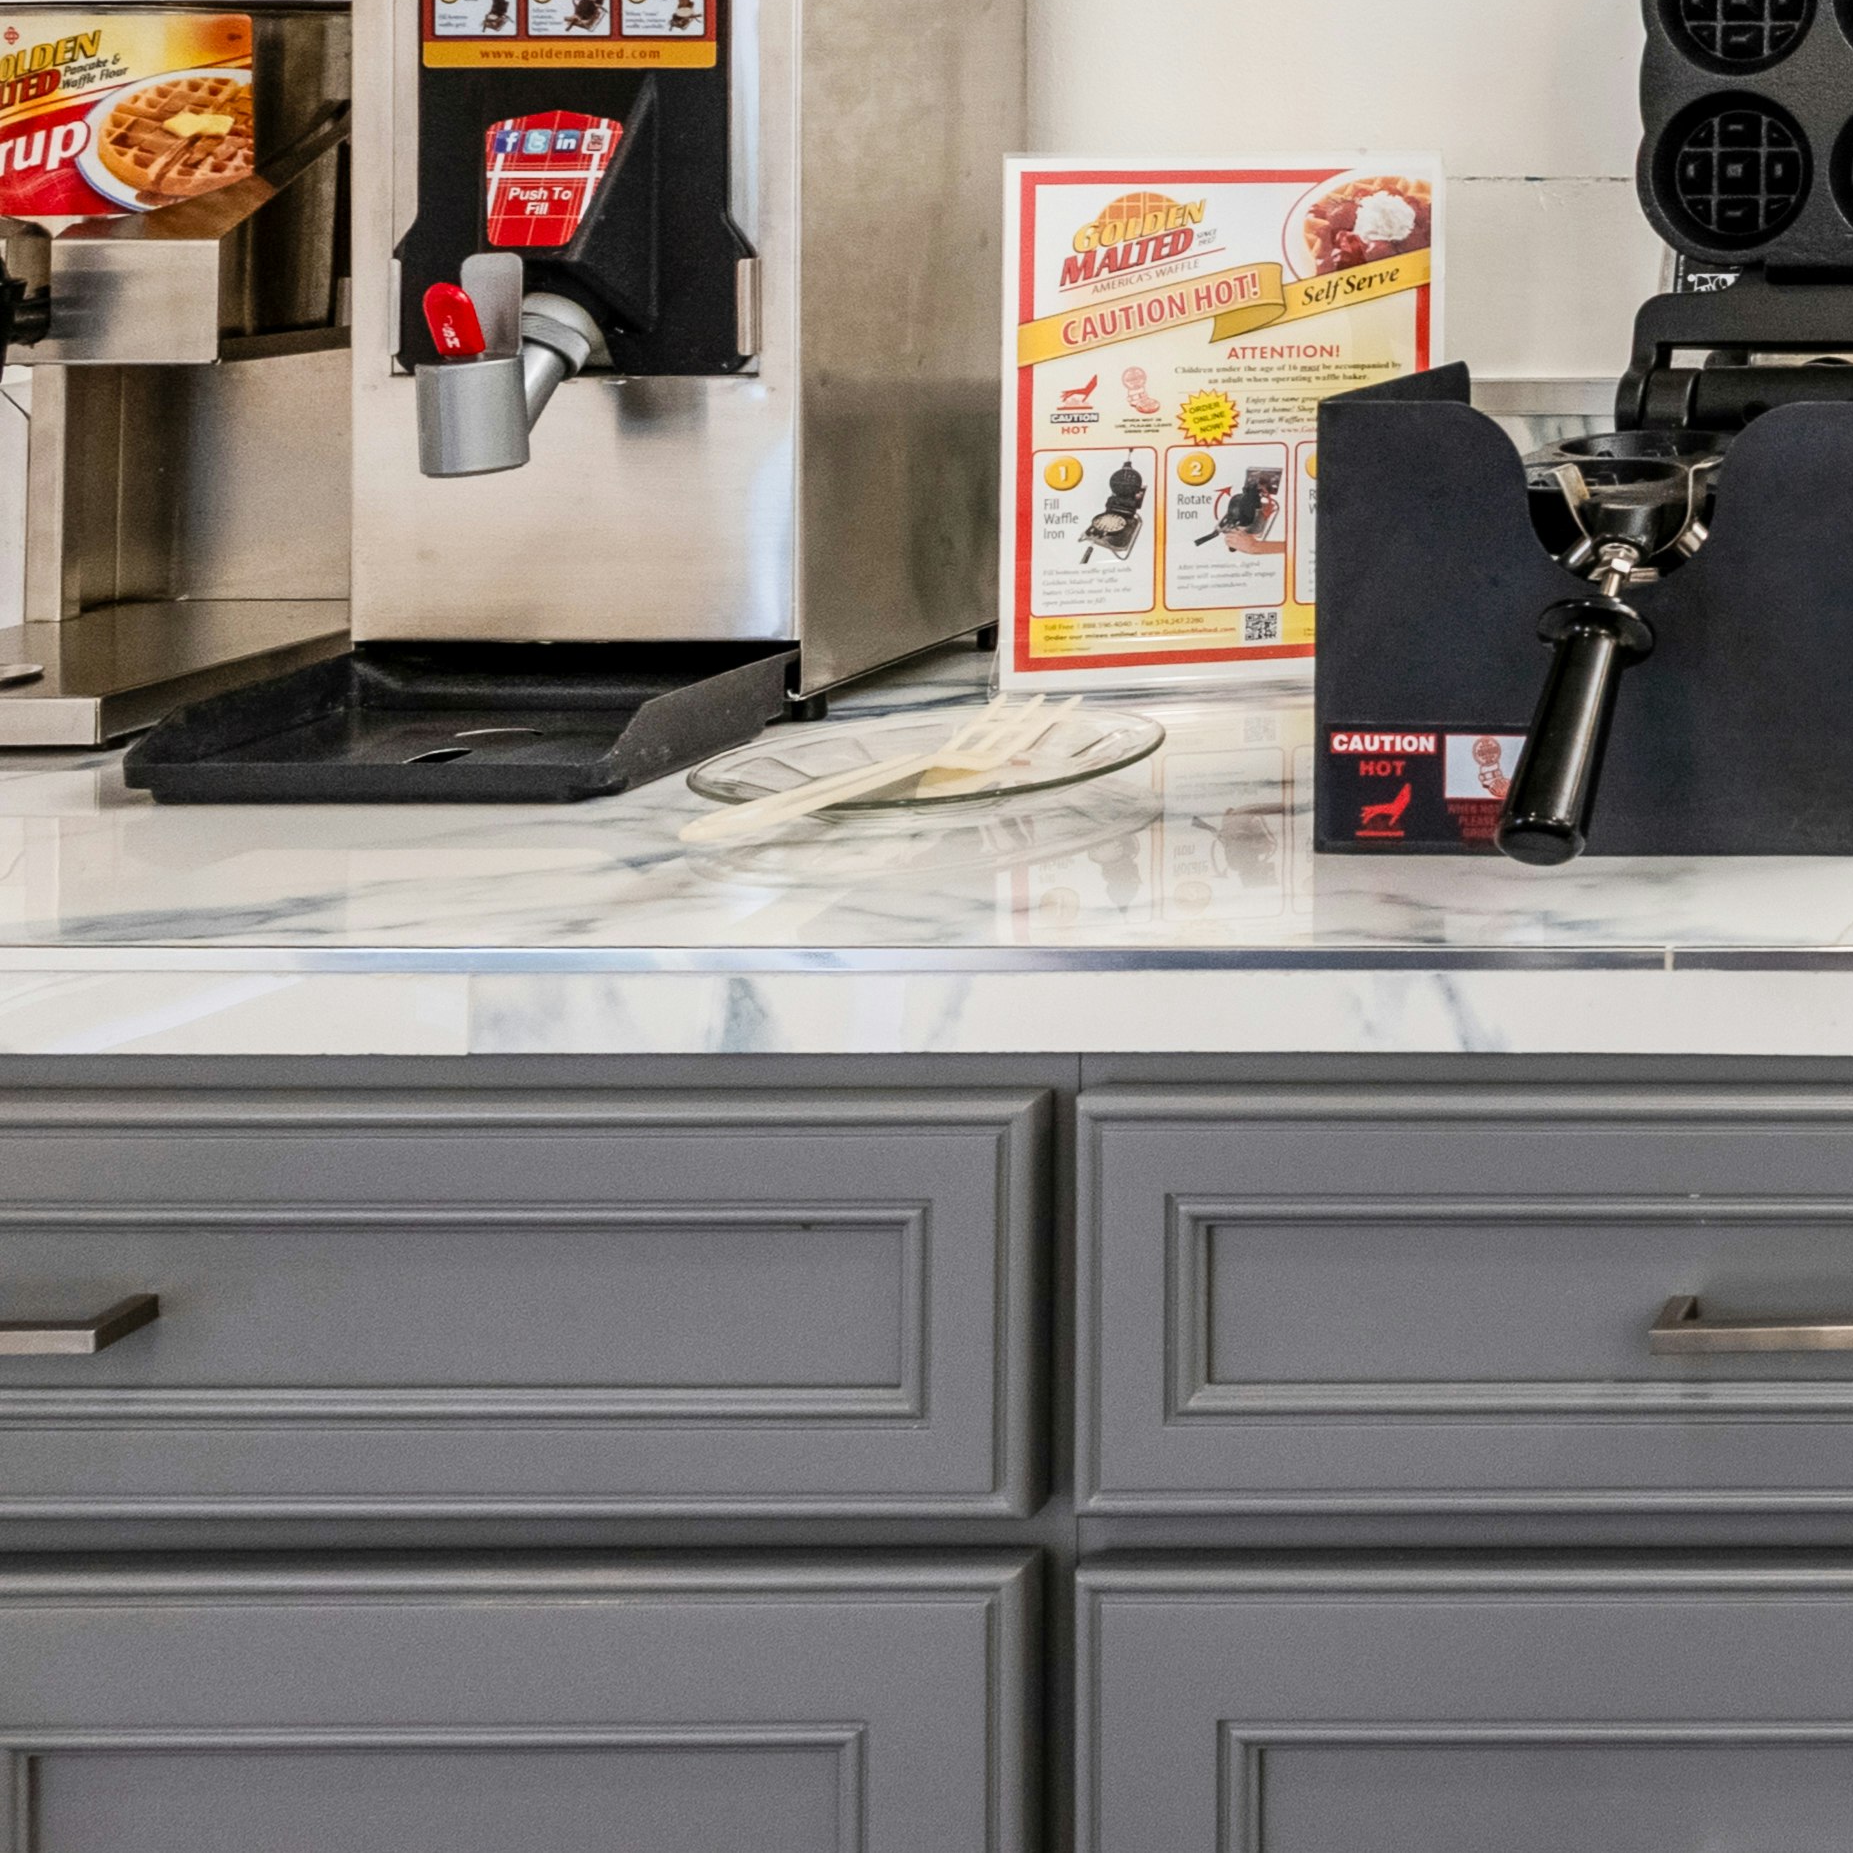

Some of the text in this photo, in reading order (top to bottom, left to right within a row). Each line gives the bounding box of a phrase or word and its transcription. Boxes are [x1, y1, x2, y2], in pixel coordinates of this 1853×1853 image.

[480, 47, 661, 61] www.goldenmalted.com
[63, 53, 121, 77] Pancake &
[62, 67, 129, 90] Waffle Flour
[508, 186, 572, 201] Push To
[525, 202, 549, 215] Fill
[1073, 199, 1206, 253] GOLDEN
[1059, 227, 1194, 287] MALTED
[1091, 258, 1200, 295] AMERICA'S WAFFLE
[1301, 266, 1400, 306] Self Serve
[1062, 272, 1259, 345] CAUTION HOT!
[1226, 344, 1341, 360] ATTENTION!
[1174, 365, 1214, 375] Children
[1216, 365, 1242, 374] under
[1244, 364, 1258, 373] the
[1260, 365, 1275, 375] age
[1276, 363, 1287, 372] of
[1288, 363, 1298, 372] 16
[1322, 362, 1333, 371] be
[1334, 361, 1390, 372] accompanied
[1391, 360, 1402, 370] by
[1221, 375, 1244, 384] adult
[1271, 374, 1312, 385] operating
[1189, 401, 1221, 415] ORDER
[1052, 414, 1099, 423] CAUTION
[1192, 411, 1226, 425] ONLINE
[1061, 425, 1089, 435] HOT
[1199, 422, 1224, 434] NOW!
[1058, 466, 1067, 483] 1
[1190, 461, 1202, 477] 2
[1043, 498, 1060, 510] Fill
[1177, 493, 1212, 506] Rotate
[1043, 511, 1079, 525] Waffle
[1177, 508, 1198, 521] Iron
[1043, 528, 1065, 540] Iron
[1044, 633, 1068, 642] Order
[1332, 734, 1435, 753] CAUTION
[1359, 760, 1406, 777] HOT
